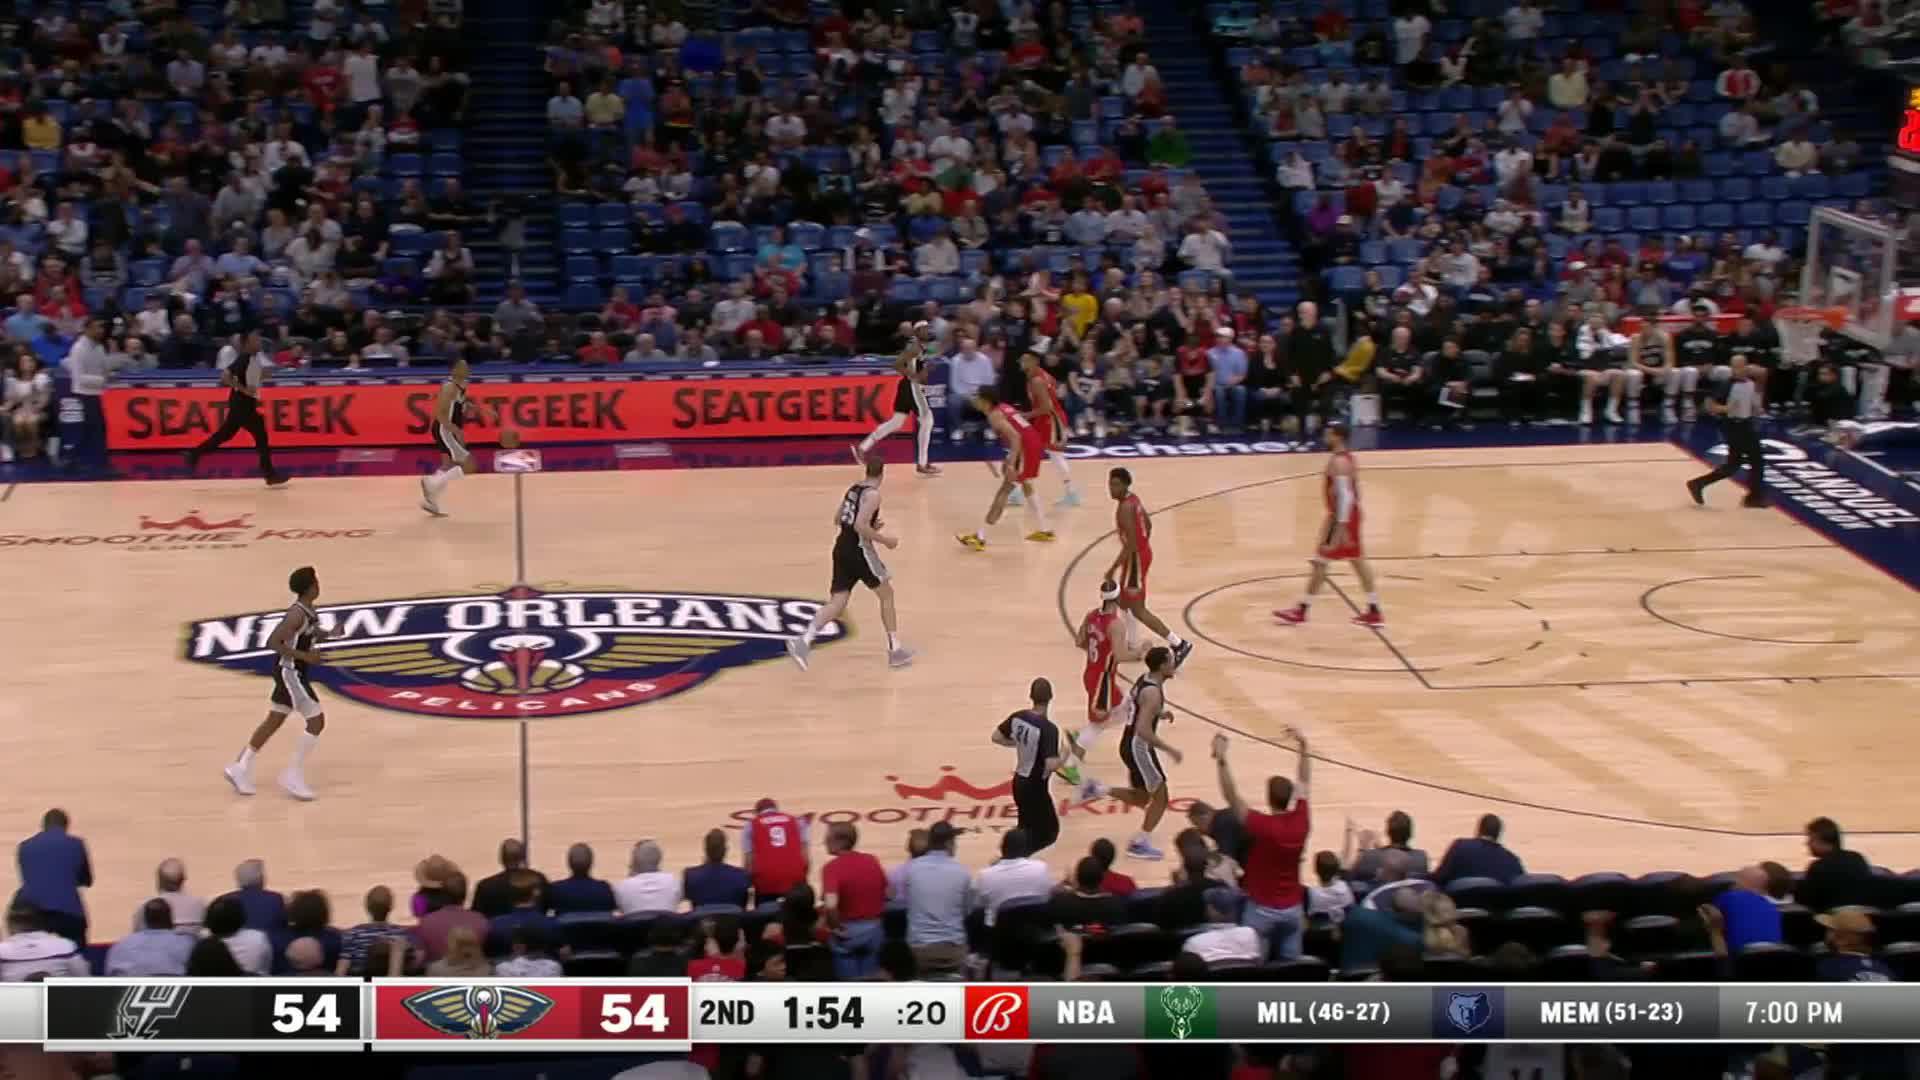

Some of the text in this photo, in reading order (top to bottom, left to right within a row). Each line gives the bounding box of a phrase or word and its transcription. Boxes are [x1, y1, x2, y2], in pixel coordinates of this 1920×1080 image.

[126, 393, 359, 439] SEATEEK
[406, 389, 628, 434] SATGEEK
[672, 384, 885, 429] SEATGEEK
[0, 532, 246, 547] SMOOTHIE
[446, 598, 840, 636] ORLEANS
[388, 680, 657, 710] PELICANS
[721, 802, 1018, 830] SOOTHIE
